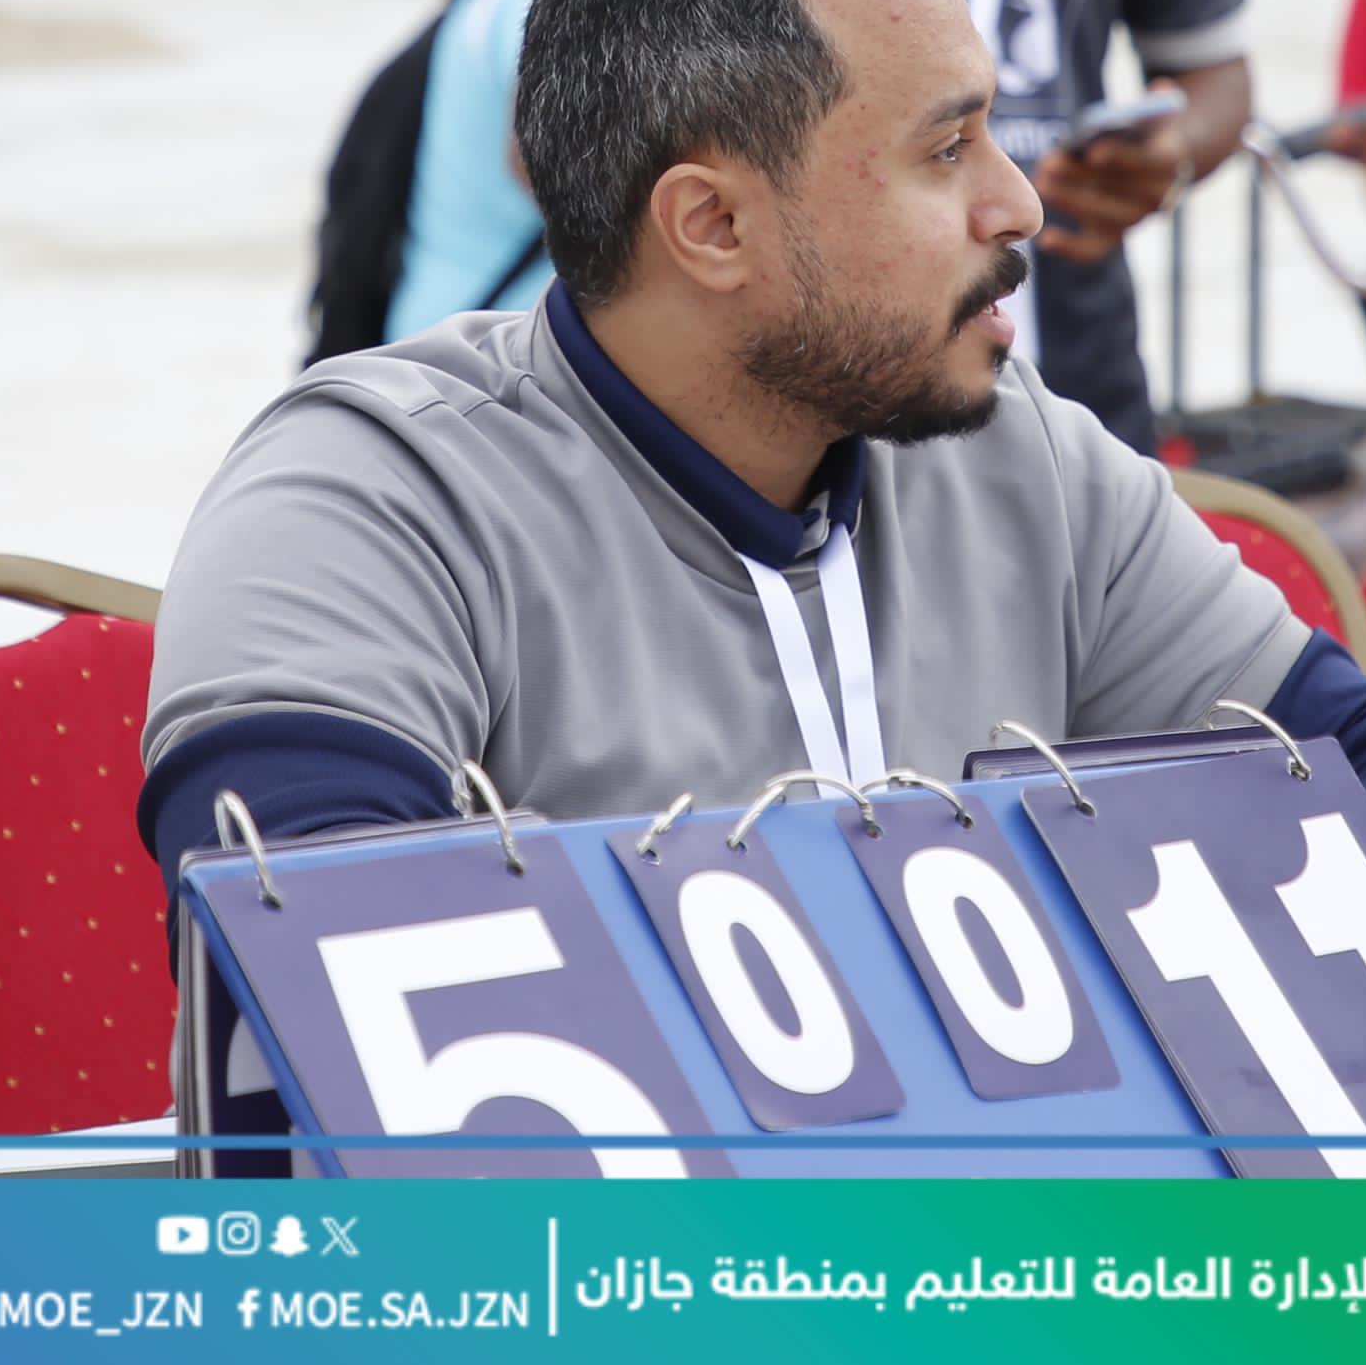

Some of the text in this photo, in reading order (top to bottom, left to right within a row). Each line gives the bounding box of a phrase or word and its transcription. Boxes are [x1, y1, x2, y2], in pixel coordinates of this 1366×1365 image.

[317, 906, 690, 1179] 5
[678, 869, 854, 1096] 0
[901, 846, 1075, 1066] 0
